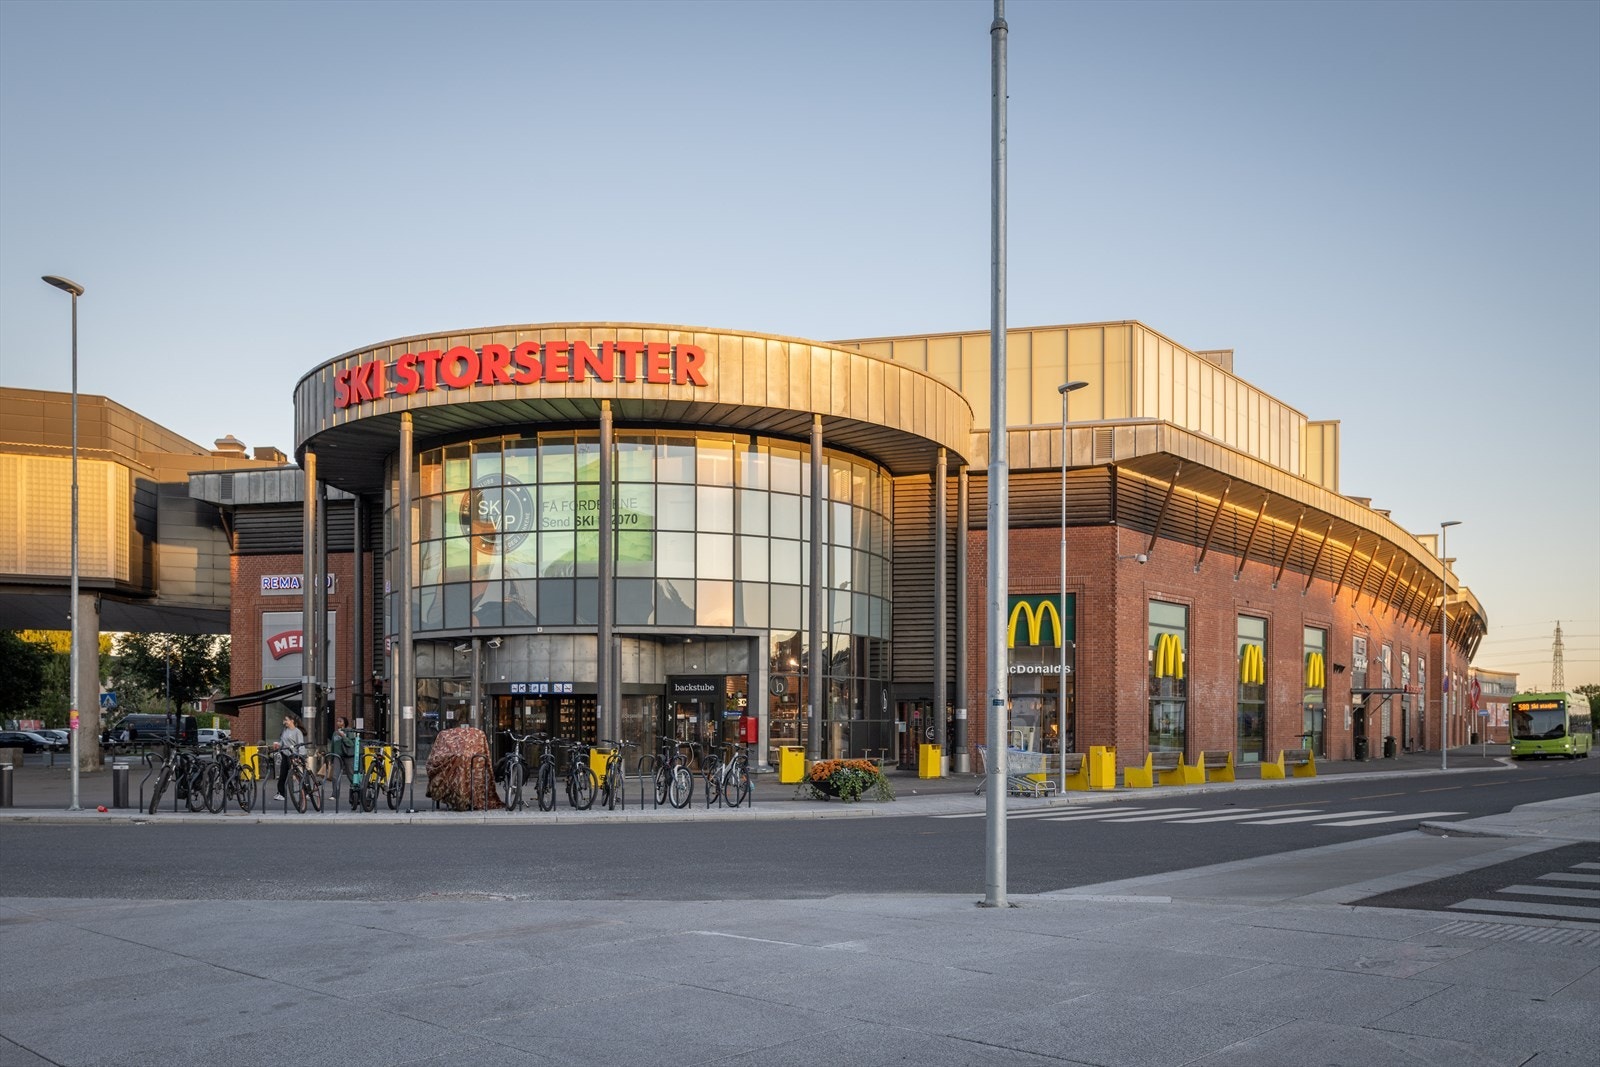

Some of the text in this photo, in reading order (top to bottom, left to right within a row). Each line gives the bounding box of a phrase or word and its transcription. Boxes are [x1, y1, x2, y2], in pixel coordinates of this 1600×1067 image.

[334, 340, 708, 408] SKI STORSENTER
[576, 515, 594, 526] SKI
[263, 577, 300, 589] REMA
[1006, 664, 1071, 674] cDonalds
[674, 683, 715, 692] backstube
